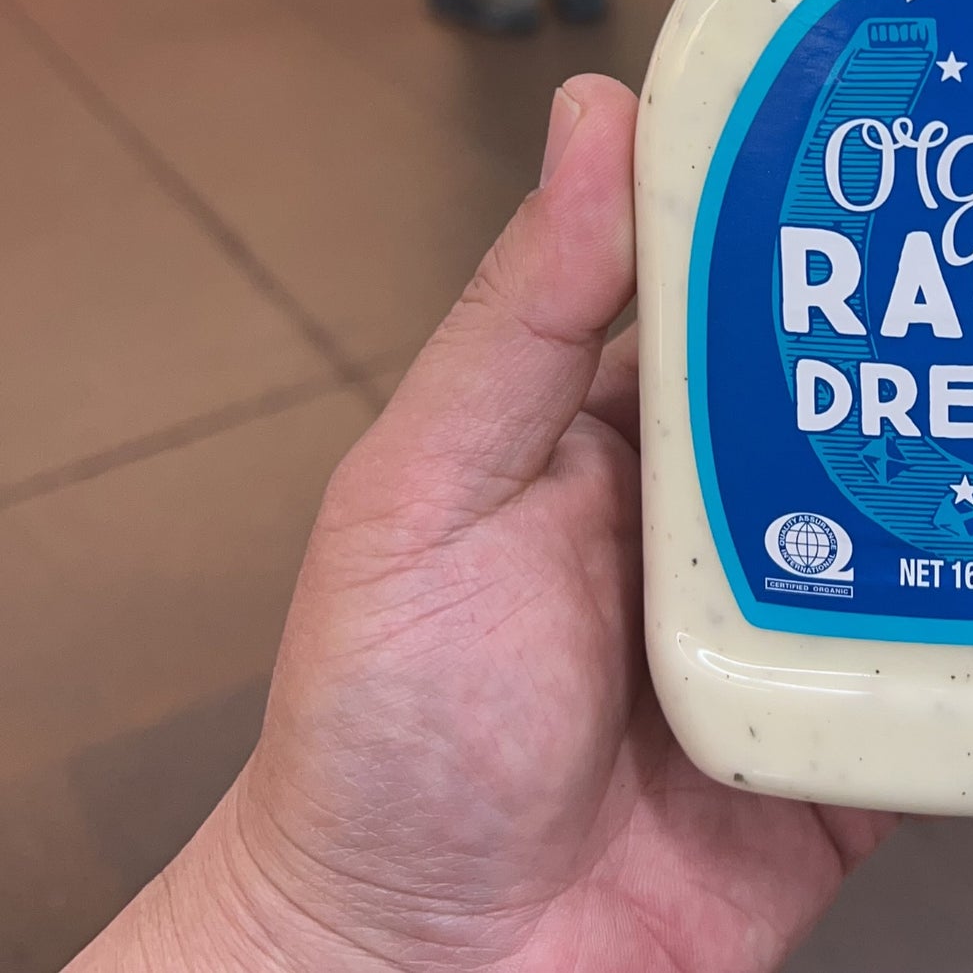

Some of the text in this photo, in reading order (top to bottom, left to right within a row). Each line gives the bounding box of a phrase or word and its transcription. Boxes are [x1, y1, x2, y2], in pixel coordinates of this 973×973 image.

[780, 515, 837, 550] QUALITY ASSURANCE
[781, 548, 836, 575] INTERNATIONAL
[899, 558, 942, 588] NET
[769, 581, 849, 595] CERTIFIED ORGANIC
